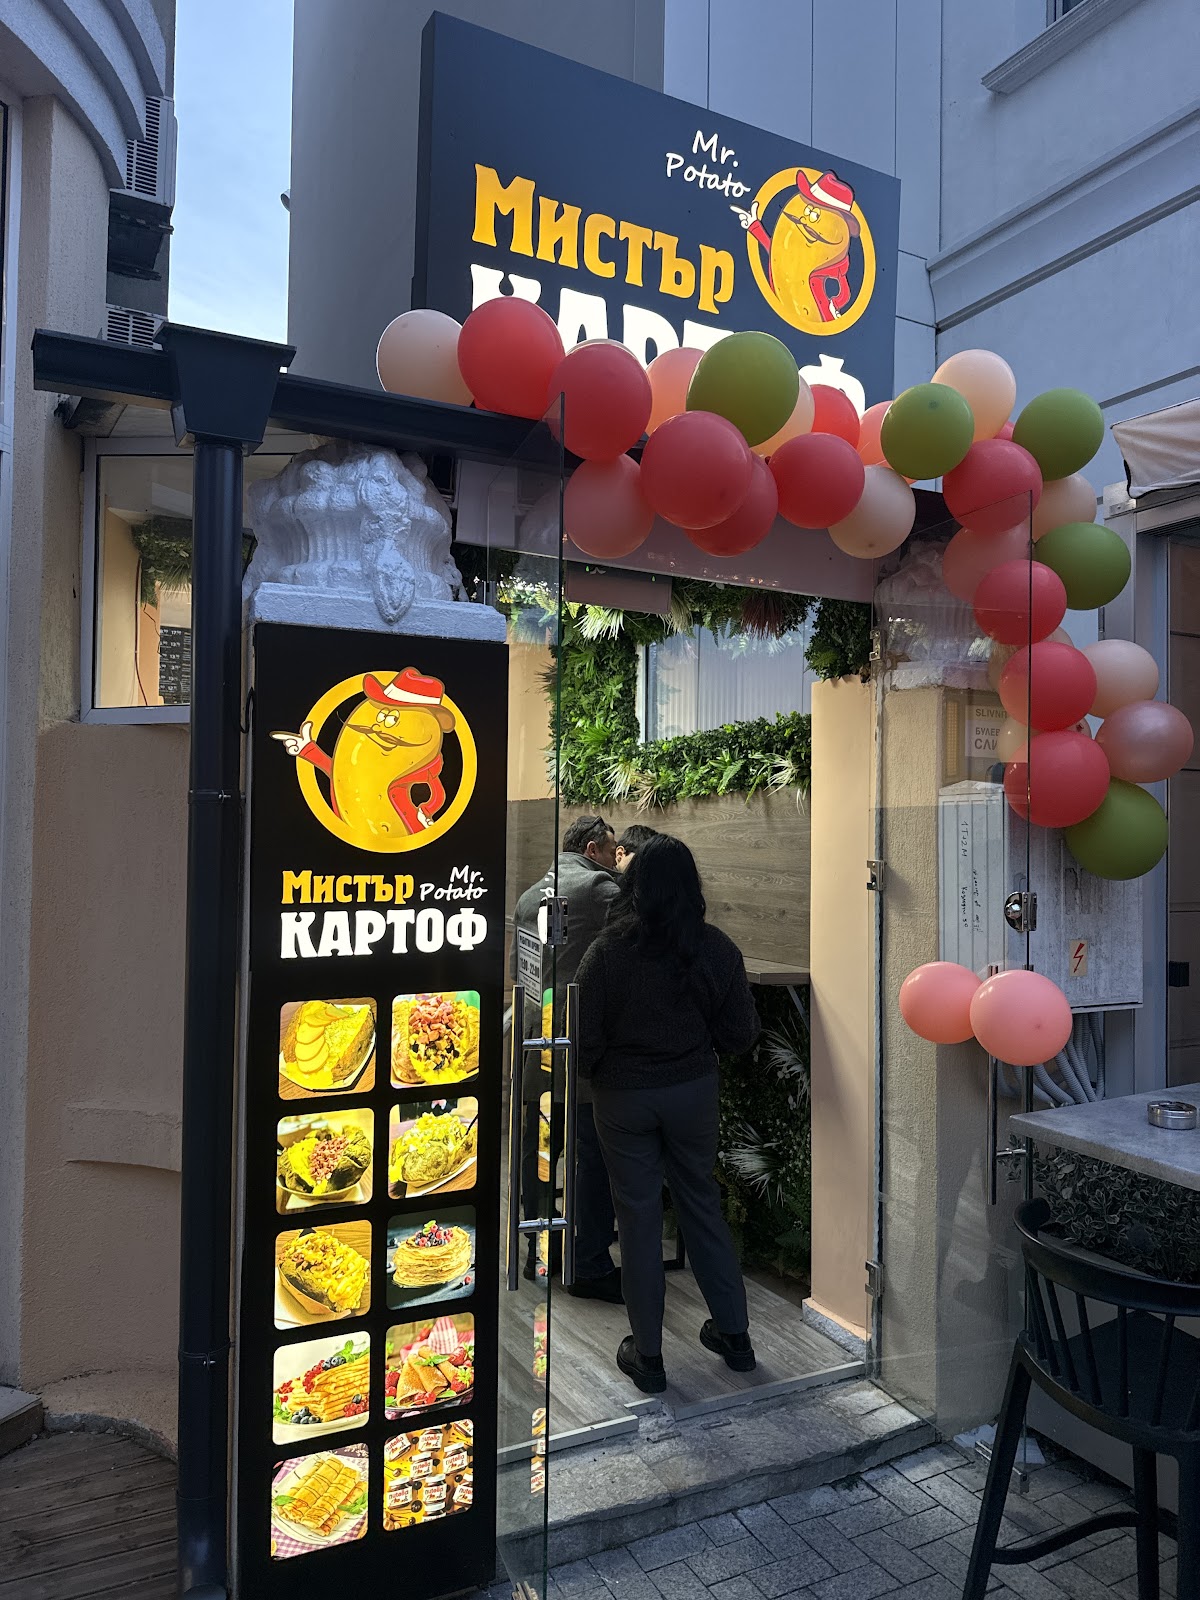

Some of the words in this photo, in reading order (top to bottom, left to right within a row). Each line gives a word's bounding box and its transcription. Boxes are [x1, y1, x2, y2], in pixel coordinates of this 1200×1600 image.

[691, 129, 739, 167] Mr.
[665, 152, 751, 198] Potato
[471, 162, 736, 315] Мистър
[281, 869, 415, 905] Мистър
[419, 882, 488, 902] Potato
[450, 864, 484, 883] Mr.
[280, 907, 488, 959] КАРТОФ
